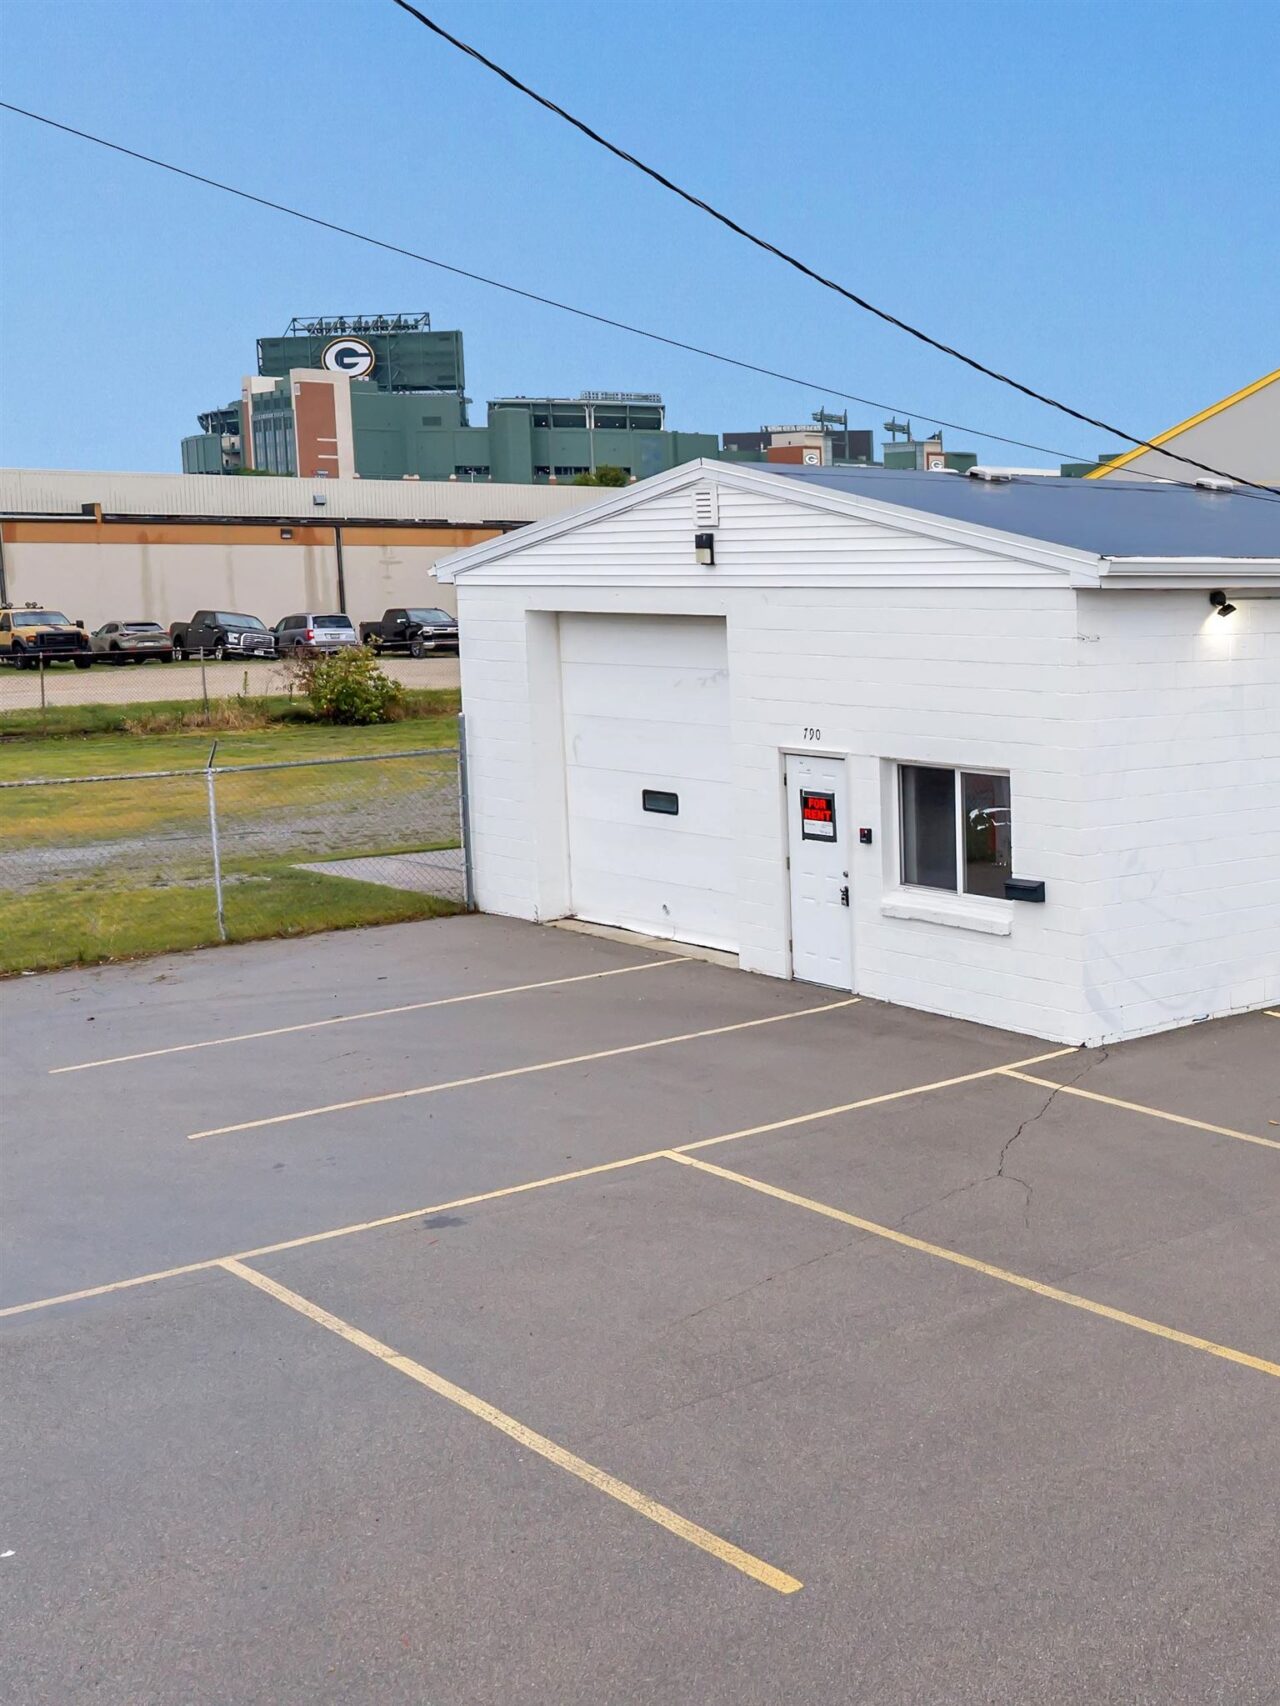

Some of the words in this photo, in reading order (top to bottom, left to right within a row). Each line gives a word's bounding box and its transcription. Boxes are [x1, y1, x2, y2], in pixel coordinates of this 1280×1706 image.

[325, 341, 371, 377] G
[803, 728, 821, 741] 790
[808, 798, 826, 809] FOR
[804, 808, 831, 821] RENT
